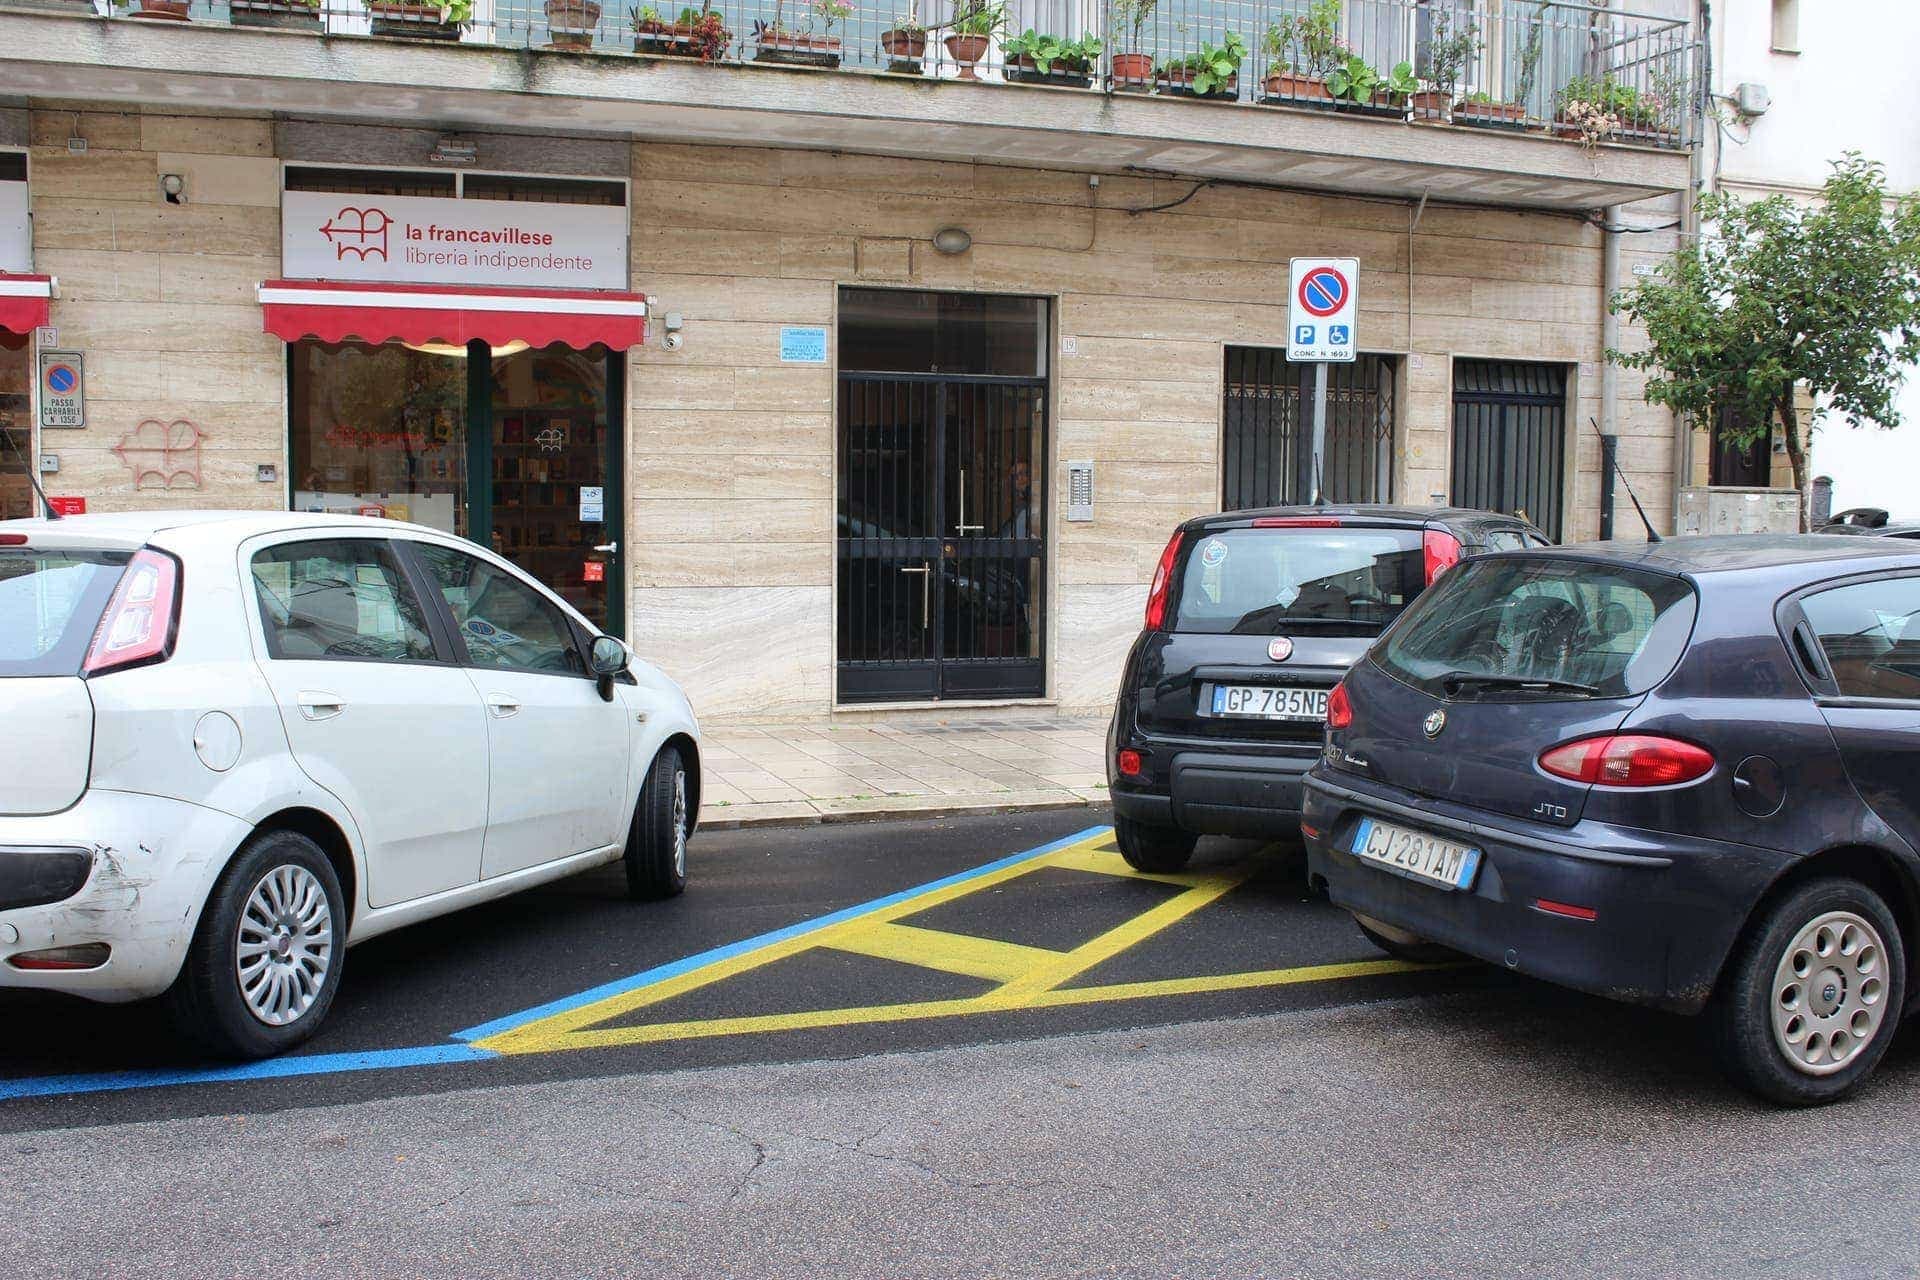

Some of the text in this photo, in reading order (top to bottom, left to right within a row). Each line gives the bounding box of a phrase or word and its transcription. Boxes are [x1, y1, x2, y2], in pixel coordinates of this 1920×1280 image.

[406, 224, 553, 246] la francavillese
[406, 248, 593, 271] libreria indipendente
[42, 332, 54, 344] 15
[1300, 327, 1312, 343] P
[44, 407, 80, 416] CARRABILE
[51, 398, 74, 407] PASSO
[1228, 688, 1328, 715] GP 785NB
[1366, 826, 1463, 880] CJ 281AM
